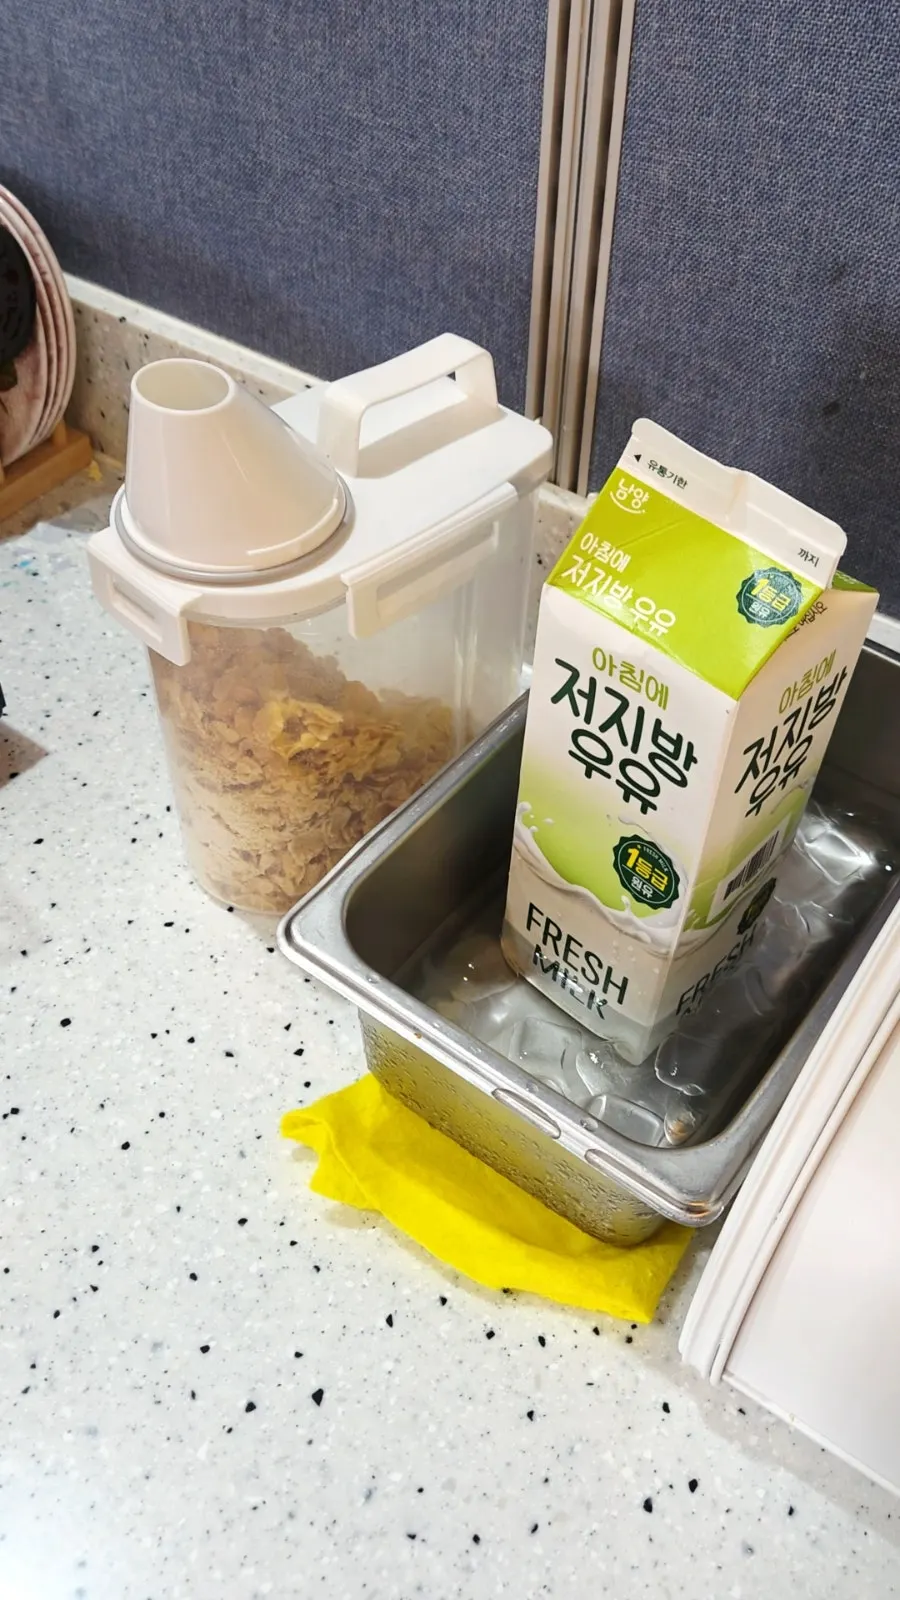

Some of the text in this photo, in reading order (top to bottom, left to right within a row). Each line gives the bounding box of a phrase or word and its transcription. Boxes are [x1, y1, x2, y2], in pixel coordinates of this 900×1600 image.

[616, 478, 650, 509] 남양
[647, 458, 819, 567] 유통기한 까지
[579, 531, 631, 573] 아침에
[751, 578, 791, 612] 1등급
[592, 647, 669, 710] 아침에
[779, 649, 837, 713] 아침에
[550, 658, 698, 788] 저지방
[735, 664, 847, 794] 저지방
[568, 729, 661, 814] 우유
[745, 738, 813, 818] 우유
[626, 847, 669, 892] 1등급
[631, 876, 654, 899] 원유
[526, 902, 629, 1005] FRESH
[533, 944, 609, 1020] MILK
